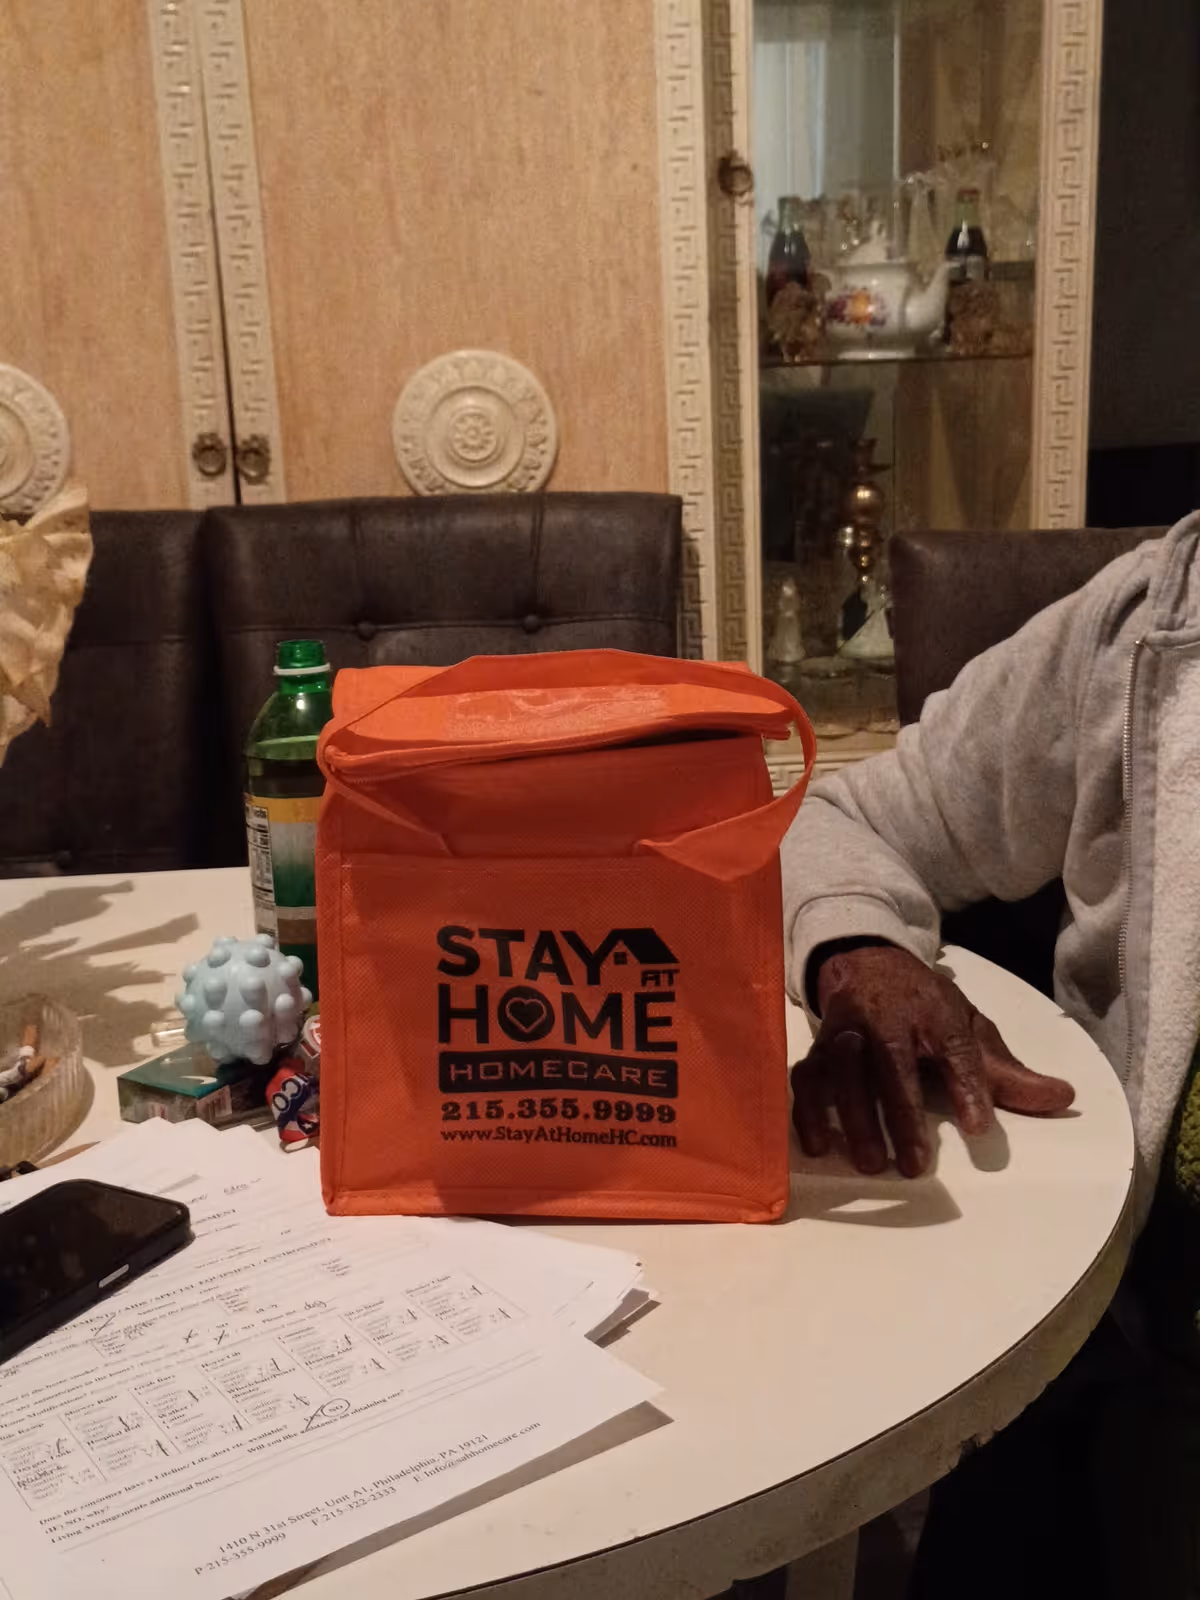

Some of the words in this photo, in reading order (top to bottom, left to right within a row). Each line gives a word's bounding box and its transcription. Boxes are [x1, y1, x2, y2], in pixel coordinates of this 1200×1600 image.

[437, 925, 622, 986] STAY
[640, 968, 680, 987] AT
[438, 983, 678, 1052] HOME
[450, 1059, 668, 1088] HOMECARE
[441, 1098, 676, 1123] 215.355.9999
[440, 1125, 678, 1148] www.StayAtHomeHC.com
[217, 1535, 248, 1554] 1410
[286, 1503, 325, 1525] Street,
[323, 1492, 350, 1509] Unit
[370, 1452, 441, 1490] Philadelphia,
[437, 1445, 457, 1460] PA
[457, 1431, 490, 1452] 19121
[322, 1485, 397, 1522] 215-322-2333
[205, 1531, 288, 1572] 215-355-9999
